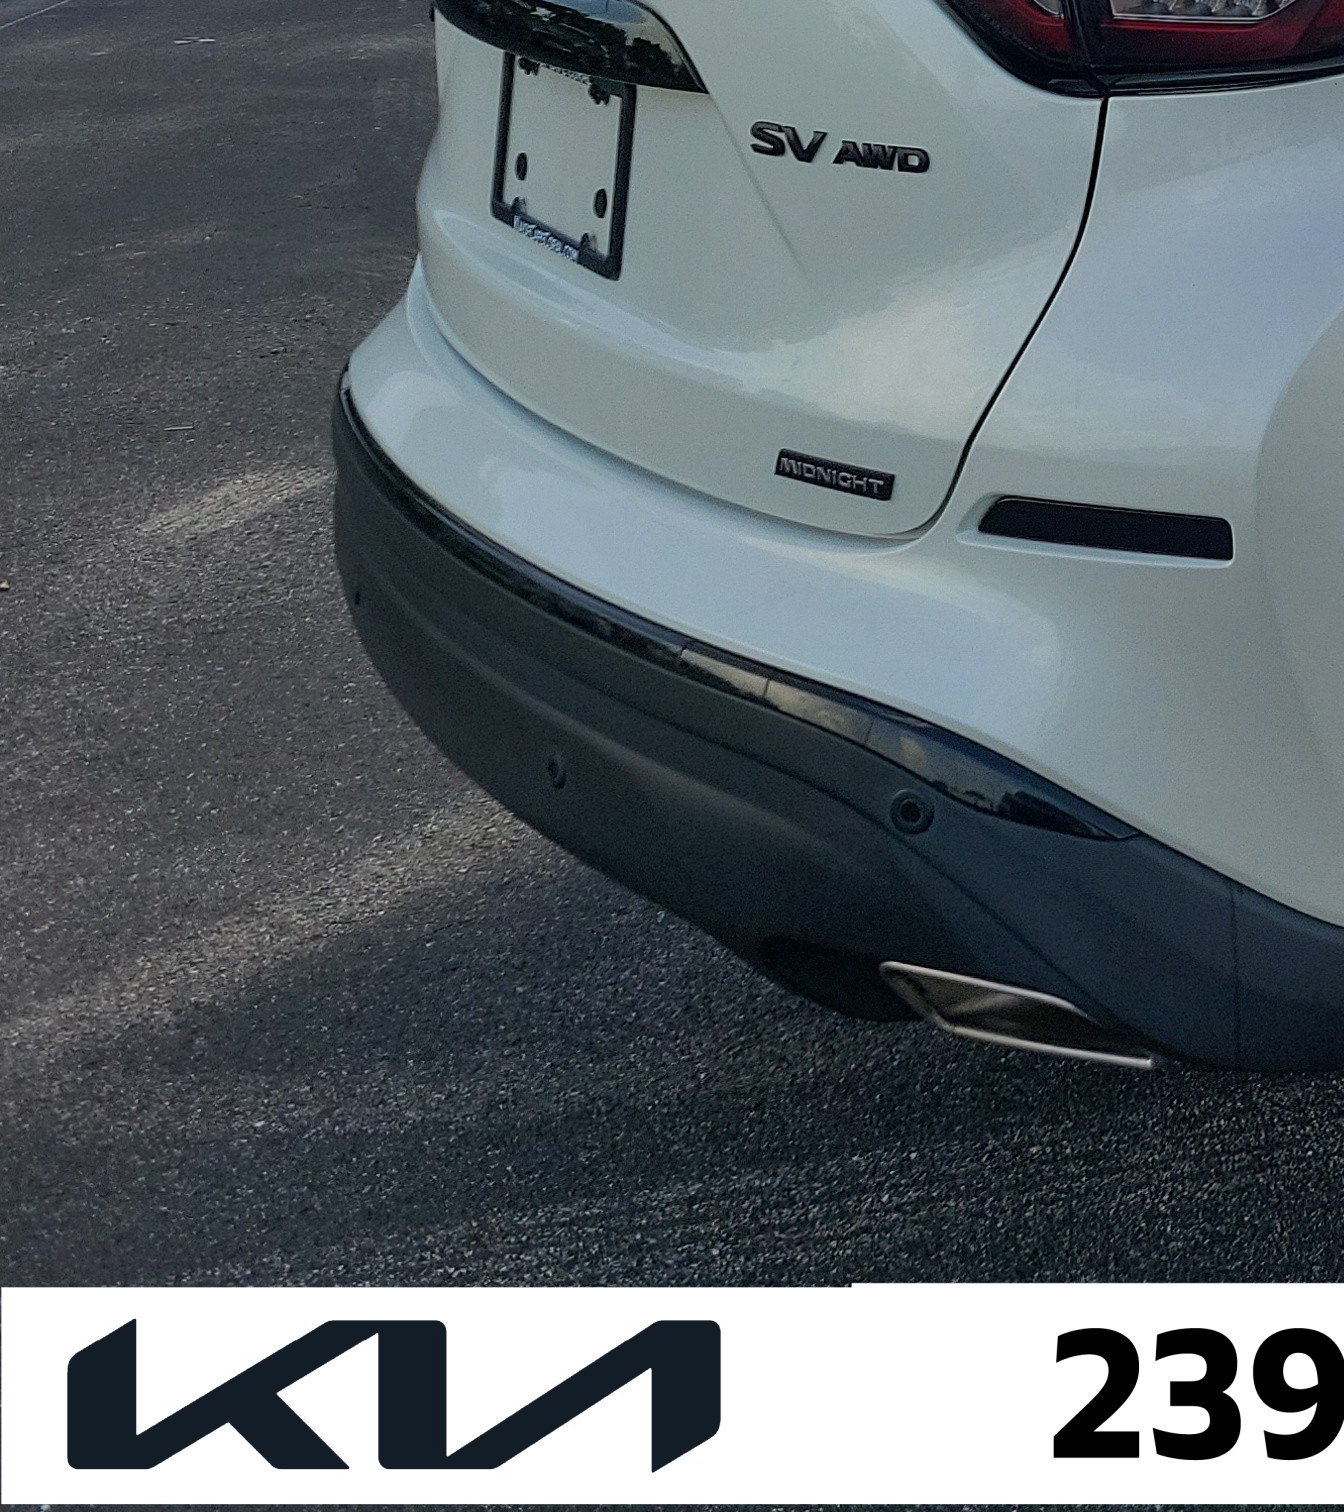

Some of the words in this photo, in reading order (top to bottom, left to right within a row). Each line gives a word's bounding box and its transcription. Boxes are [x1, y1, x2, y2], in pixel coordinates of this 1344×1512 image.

[750, 120, 828, 164] SV
[830, 140, 931, 174] AWD
[779, 456, 885, 494] MIDNIGHT
